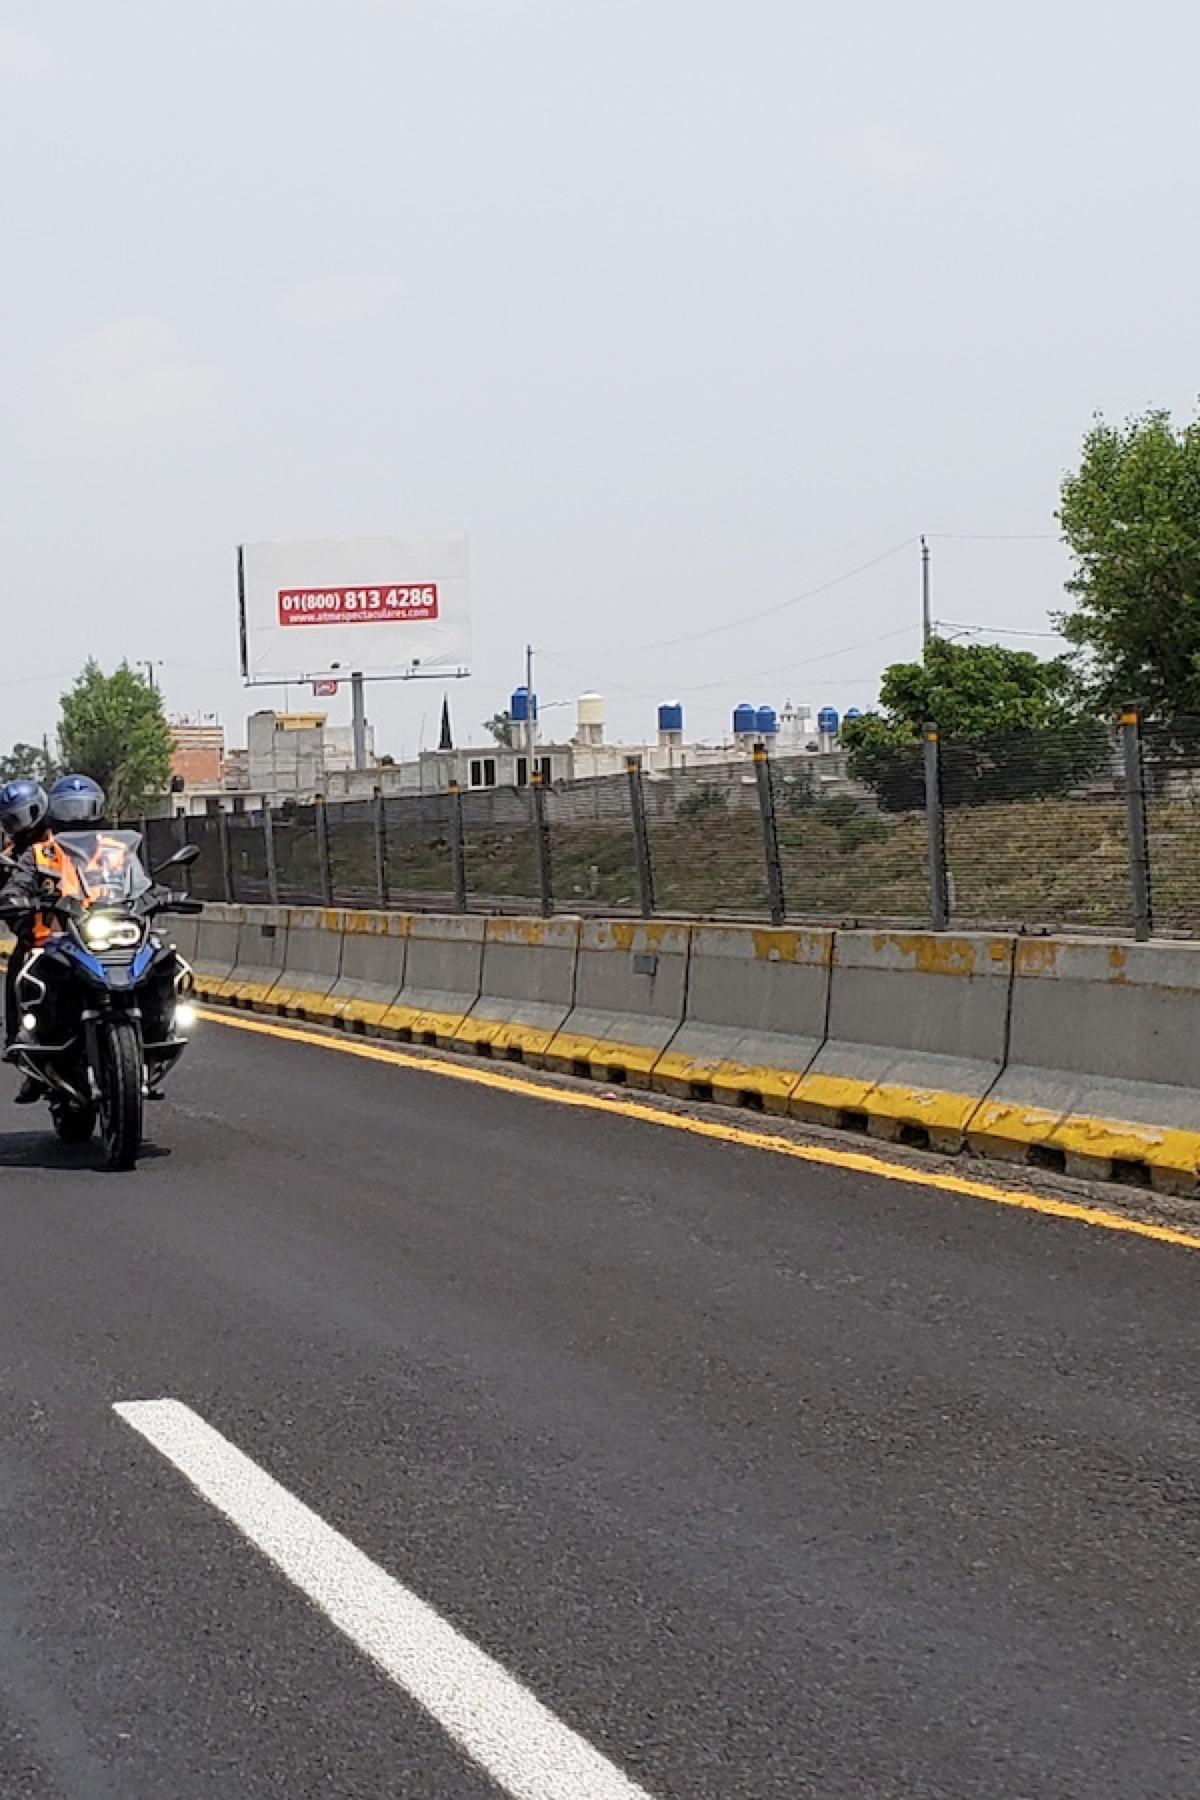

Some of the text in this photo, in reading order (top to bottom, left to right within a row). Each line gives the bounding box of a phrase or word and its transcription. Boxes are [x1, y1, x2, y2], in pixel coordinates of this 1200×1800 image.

[282, 587, 434, 611] 01(800) 813 4286
